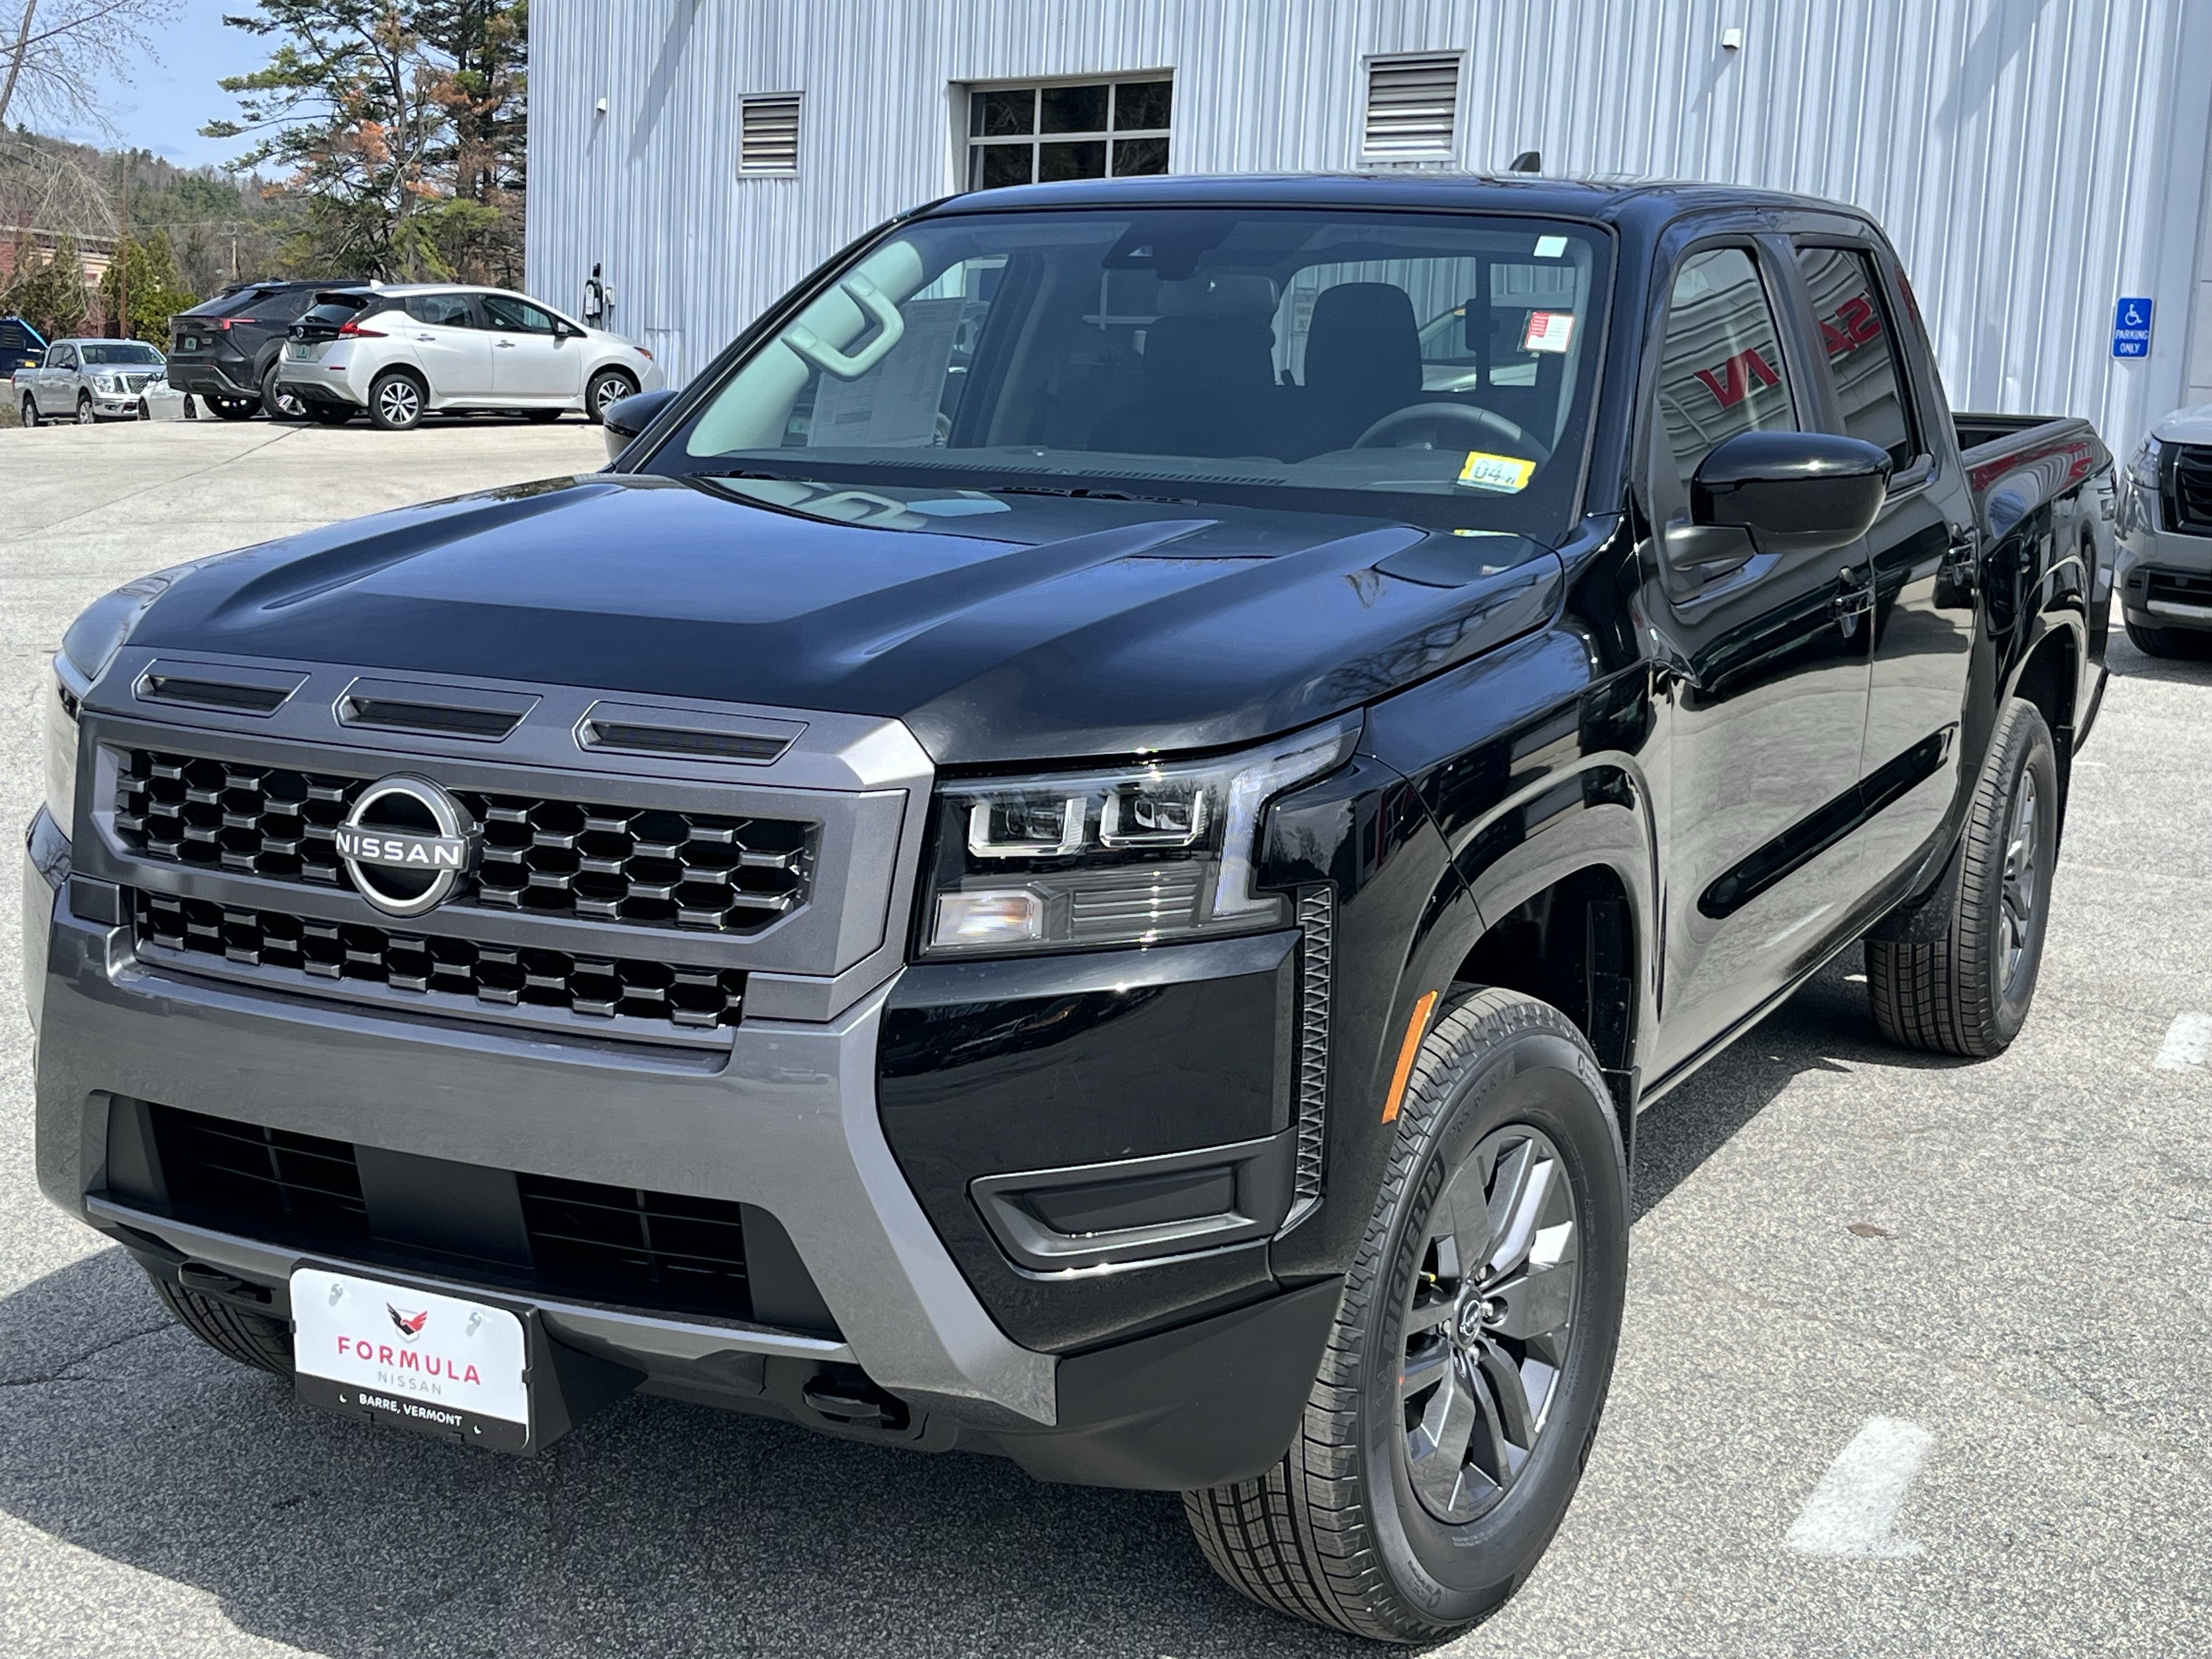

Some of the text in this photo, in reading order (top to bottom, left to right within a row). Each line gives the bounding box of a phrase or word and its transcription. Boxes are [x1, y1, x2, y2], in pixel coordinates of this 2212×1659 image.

[2115, 329, 2149, 340] PARKING
[2119, 342, 2141, 354] ONLY
[336, 831, 459, 865] NISSAN
[1383, 1160, 1442, 1355] MICHELIN
[337, 1335, 481, 1386] FORMULA
[378, 1370, 442, 1396] NISSAN
[359, 1393, 463, 1426] BARRE, VERMONT
